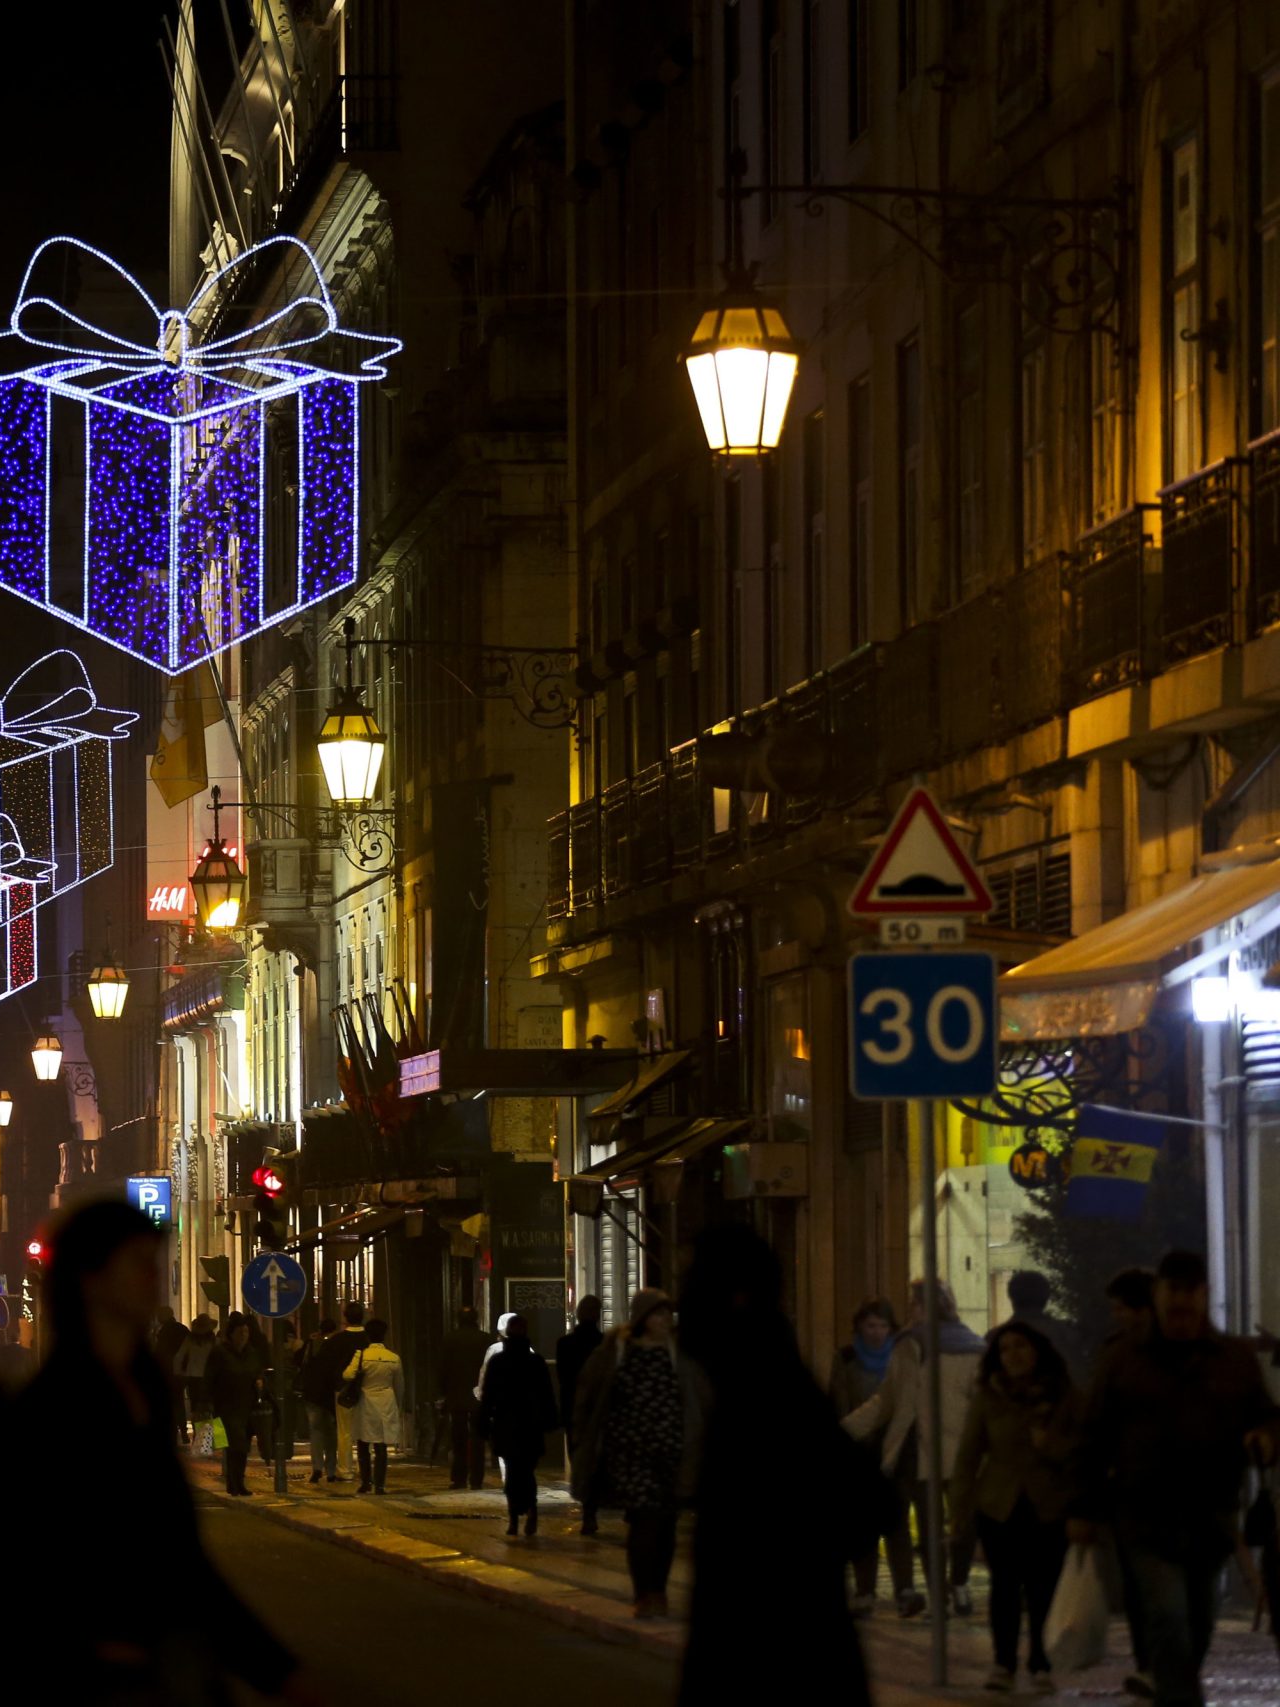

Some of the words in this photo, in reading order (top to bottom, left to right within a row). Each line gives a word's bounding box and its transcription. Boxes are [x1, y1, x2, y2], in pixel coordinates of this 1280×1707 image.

[150, 887, 187, 912] H&M
[888, 922, 922, 942] 50
[938, 925, 959, 941] m
[859, 985, 985, 1066] 30
[139, 1187, 159, 1210] P
